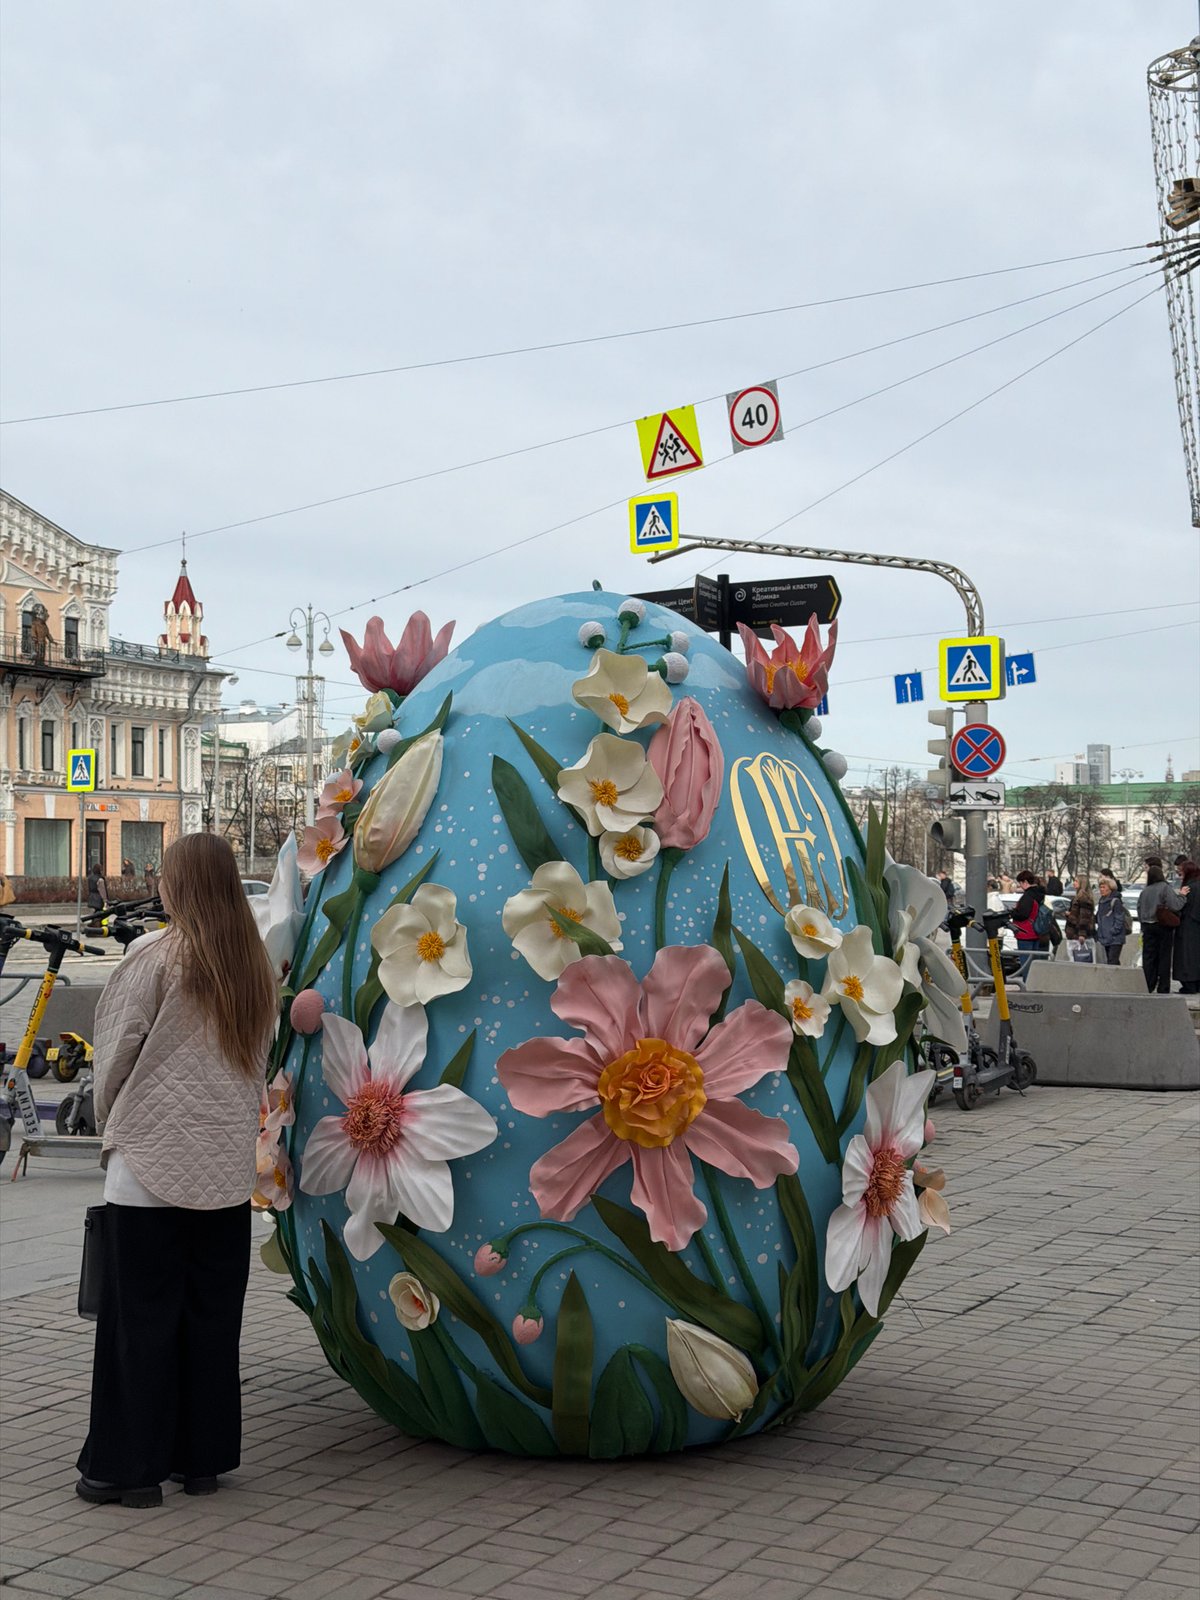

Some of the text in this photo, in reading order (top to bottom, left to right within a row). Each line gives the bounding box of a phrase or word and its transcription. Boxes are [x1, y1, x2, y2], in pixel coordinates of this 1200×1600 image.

[741, 403, 768, 429] 40
[752, 582, 818, 594] Креативный кластер
[752, 593, 780, 602] «Домна»
[16, 1090, 39, 1135] AN1335
